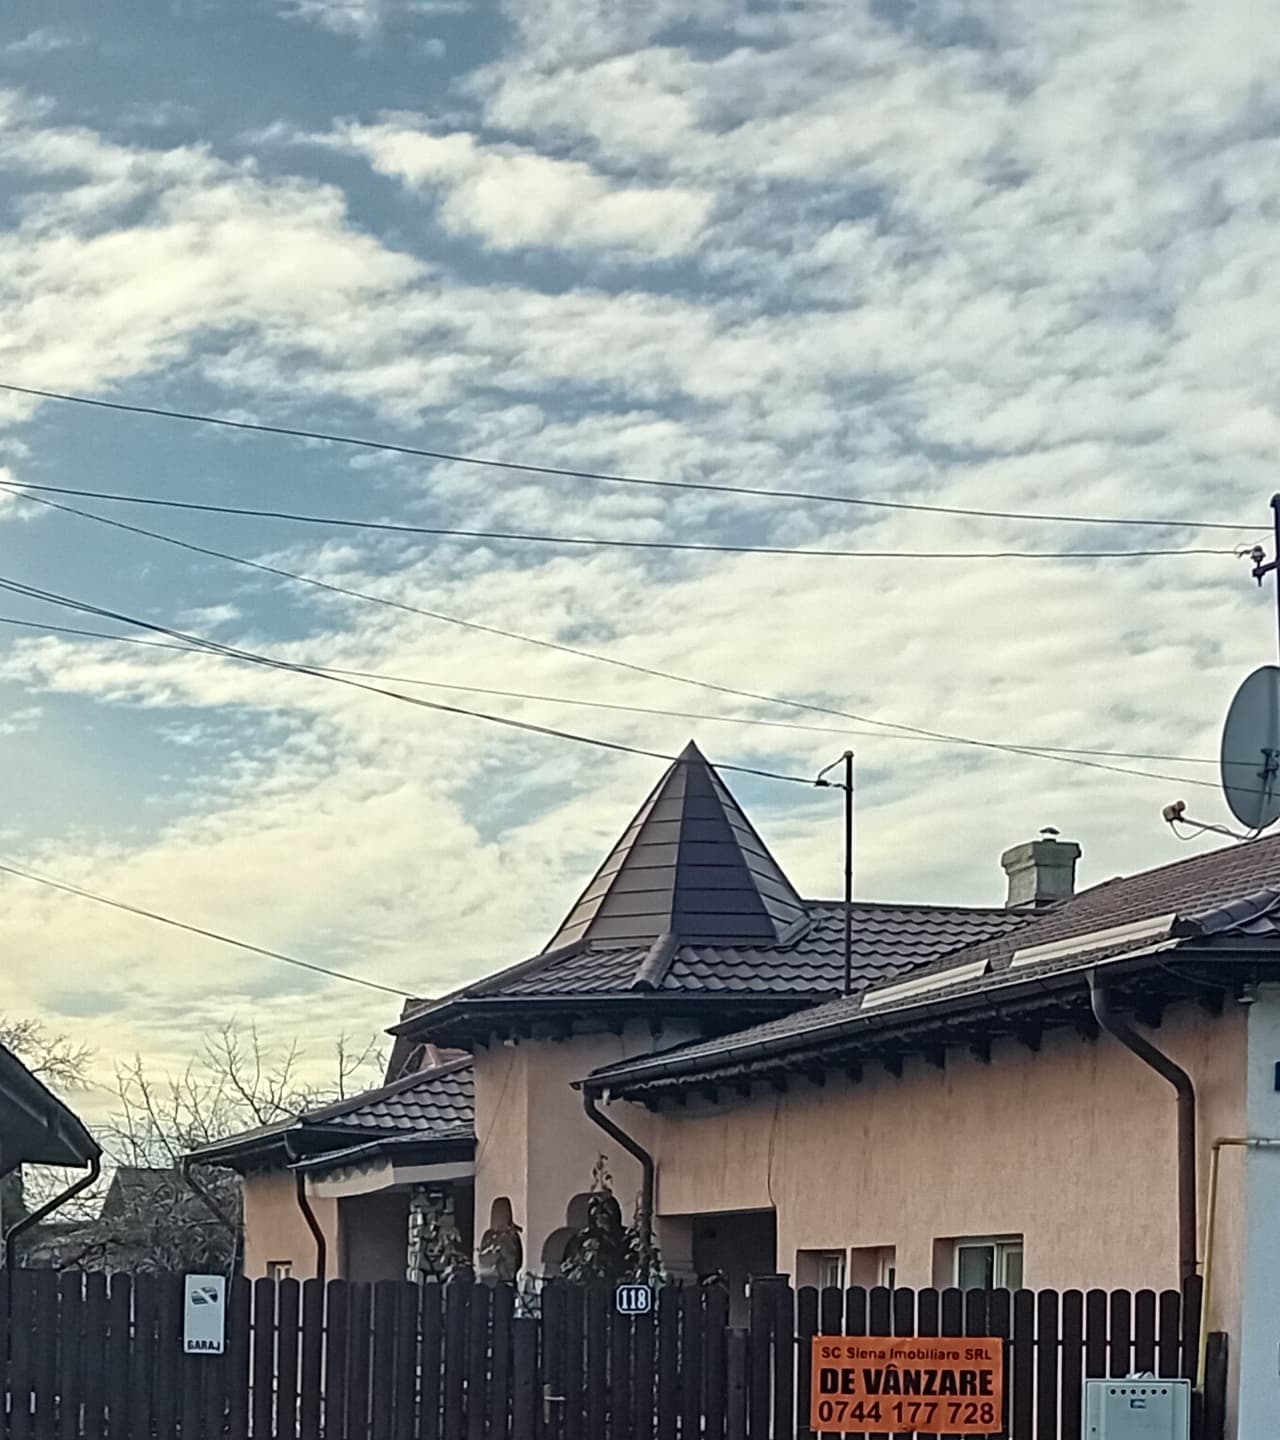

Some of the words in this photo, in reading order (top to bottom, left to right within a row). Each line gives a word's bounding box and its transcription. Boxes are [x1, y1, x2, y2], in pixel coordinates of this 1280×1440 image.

[622, 1289, 646, 1309] 118
[187, 1340, 221, 1351] GARAJ
[821, 1346, 842, 1360] SC
[890, 1348, 960, 1361] Imobiliare
[964, 1349, 992, 1361] SRL
[820, 1368, 855, 1395] DE
[863, 1363, 994, 1396] VÂNZARE
[818, 1401, 882, 1423] 0744
[892, 1402, 938, 1424] 177
[947, 1402, 994, 1425] 728
